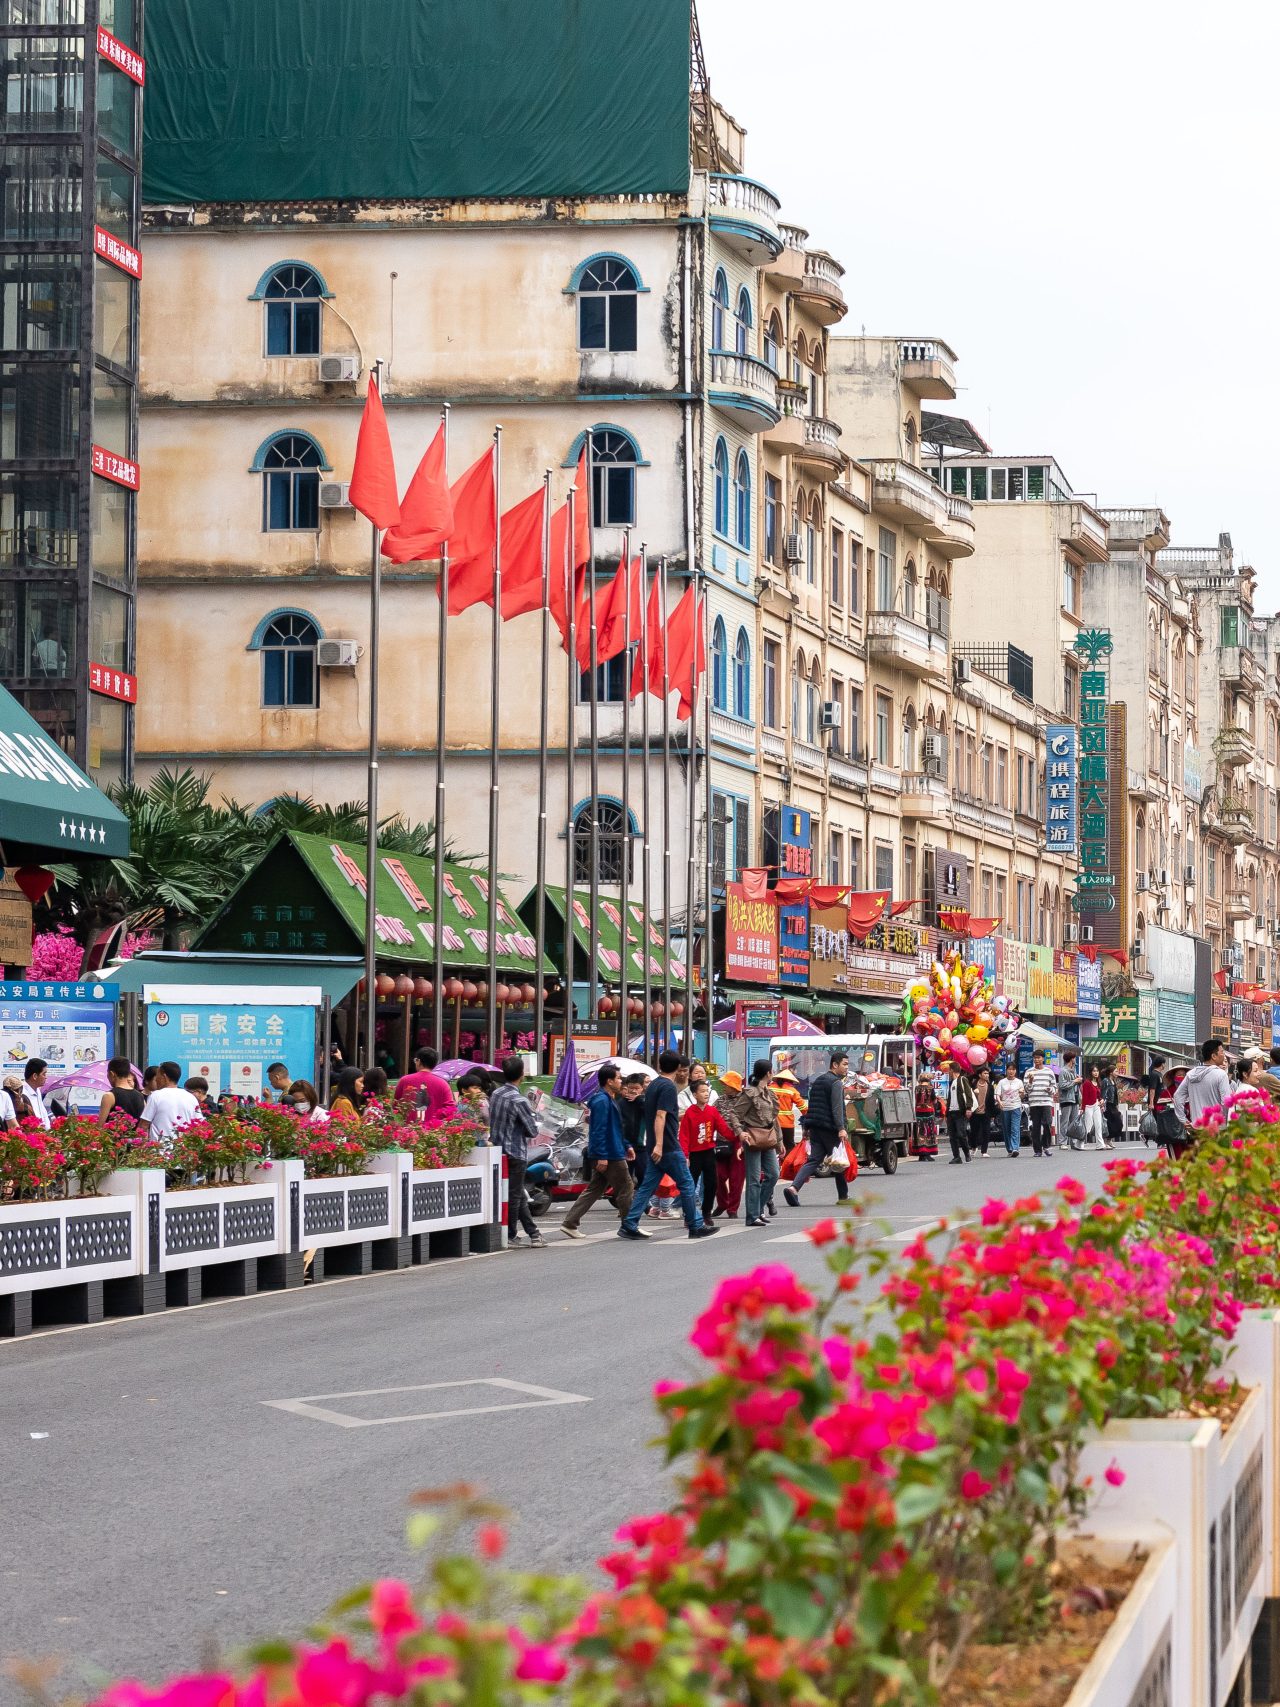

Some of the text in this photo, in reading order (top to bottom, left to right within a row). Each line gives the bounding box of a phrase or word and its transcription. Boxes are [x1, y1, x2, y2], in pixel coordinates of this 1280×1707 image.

[105, 456, 136, 485] 工艺品批发
[1080, 672, 1107, 867] 南亚风情大酒店
[1049, 762, 1070, 841] 携程旅游
[180, 1013, 285, 1036] 国家安全
